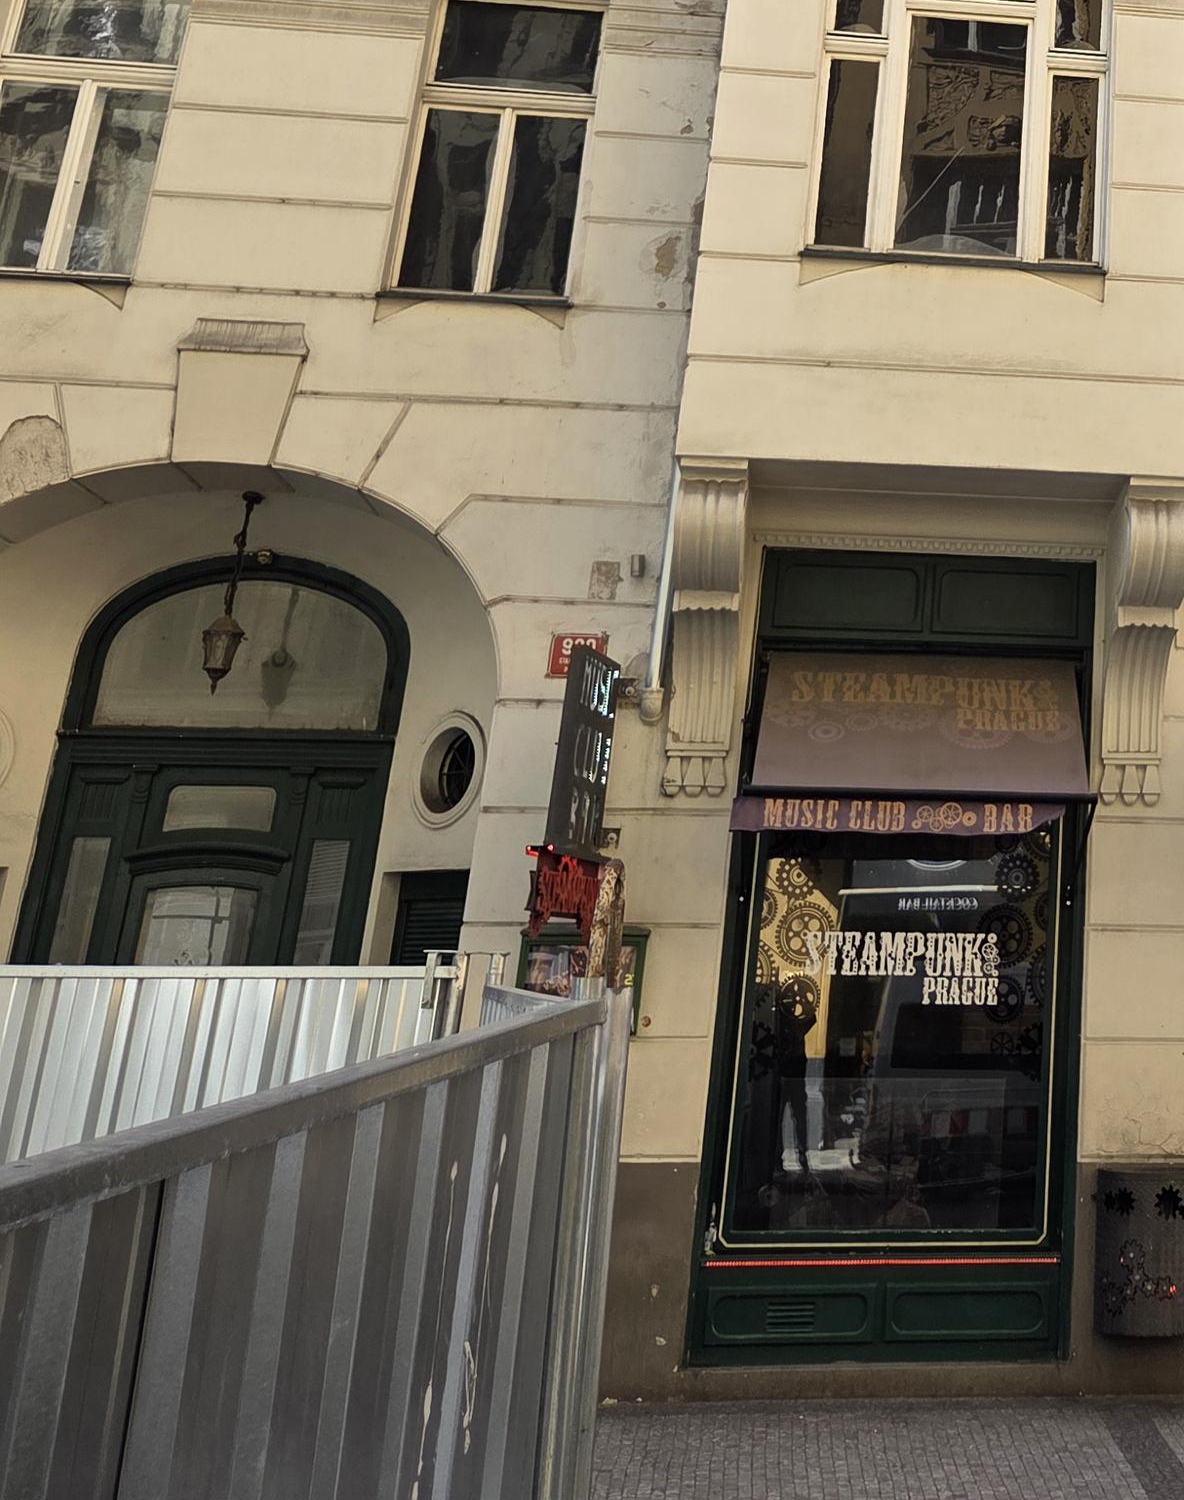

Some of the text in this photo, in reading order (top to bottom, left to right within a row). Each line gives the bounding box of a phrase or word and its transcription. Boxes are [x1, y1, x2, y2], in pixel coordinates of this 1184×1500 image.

[763, 798, 1034, 833] MUSIC CLUB BAR
[801, 931, 984, 977] STEAMPUNK
[922, 977, 999, 1006] PRAGUE
